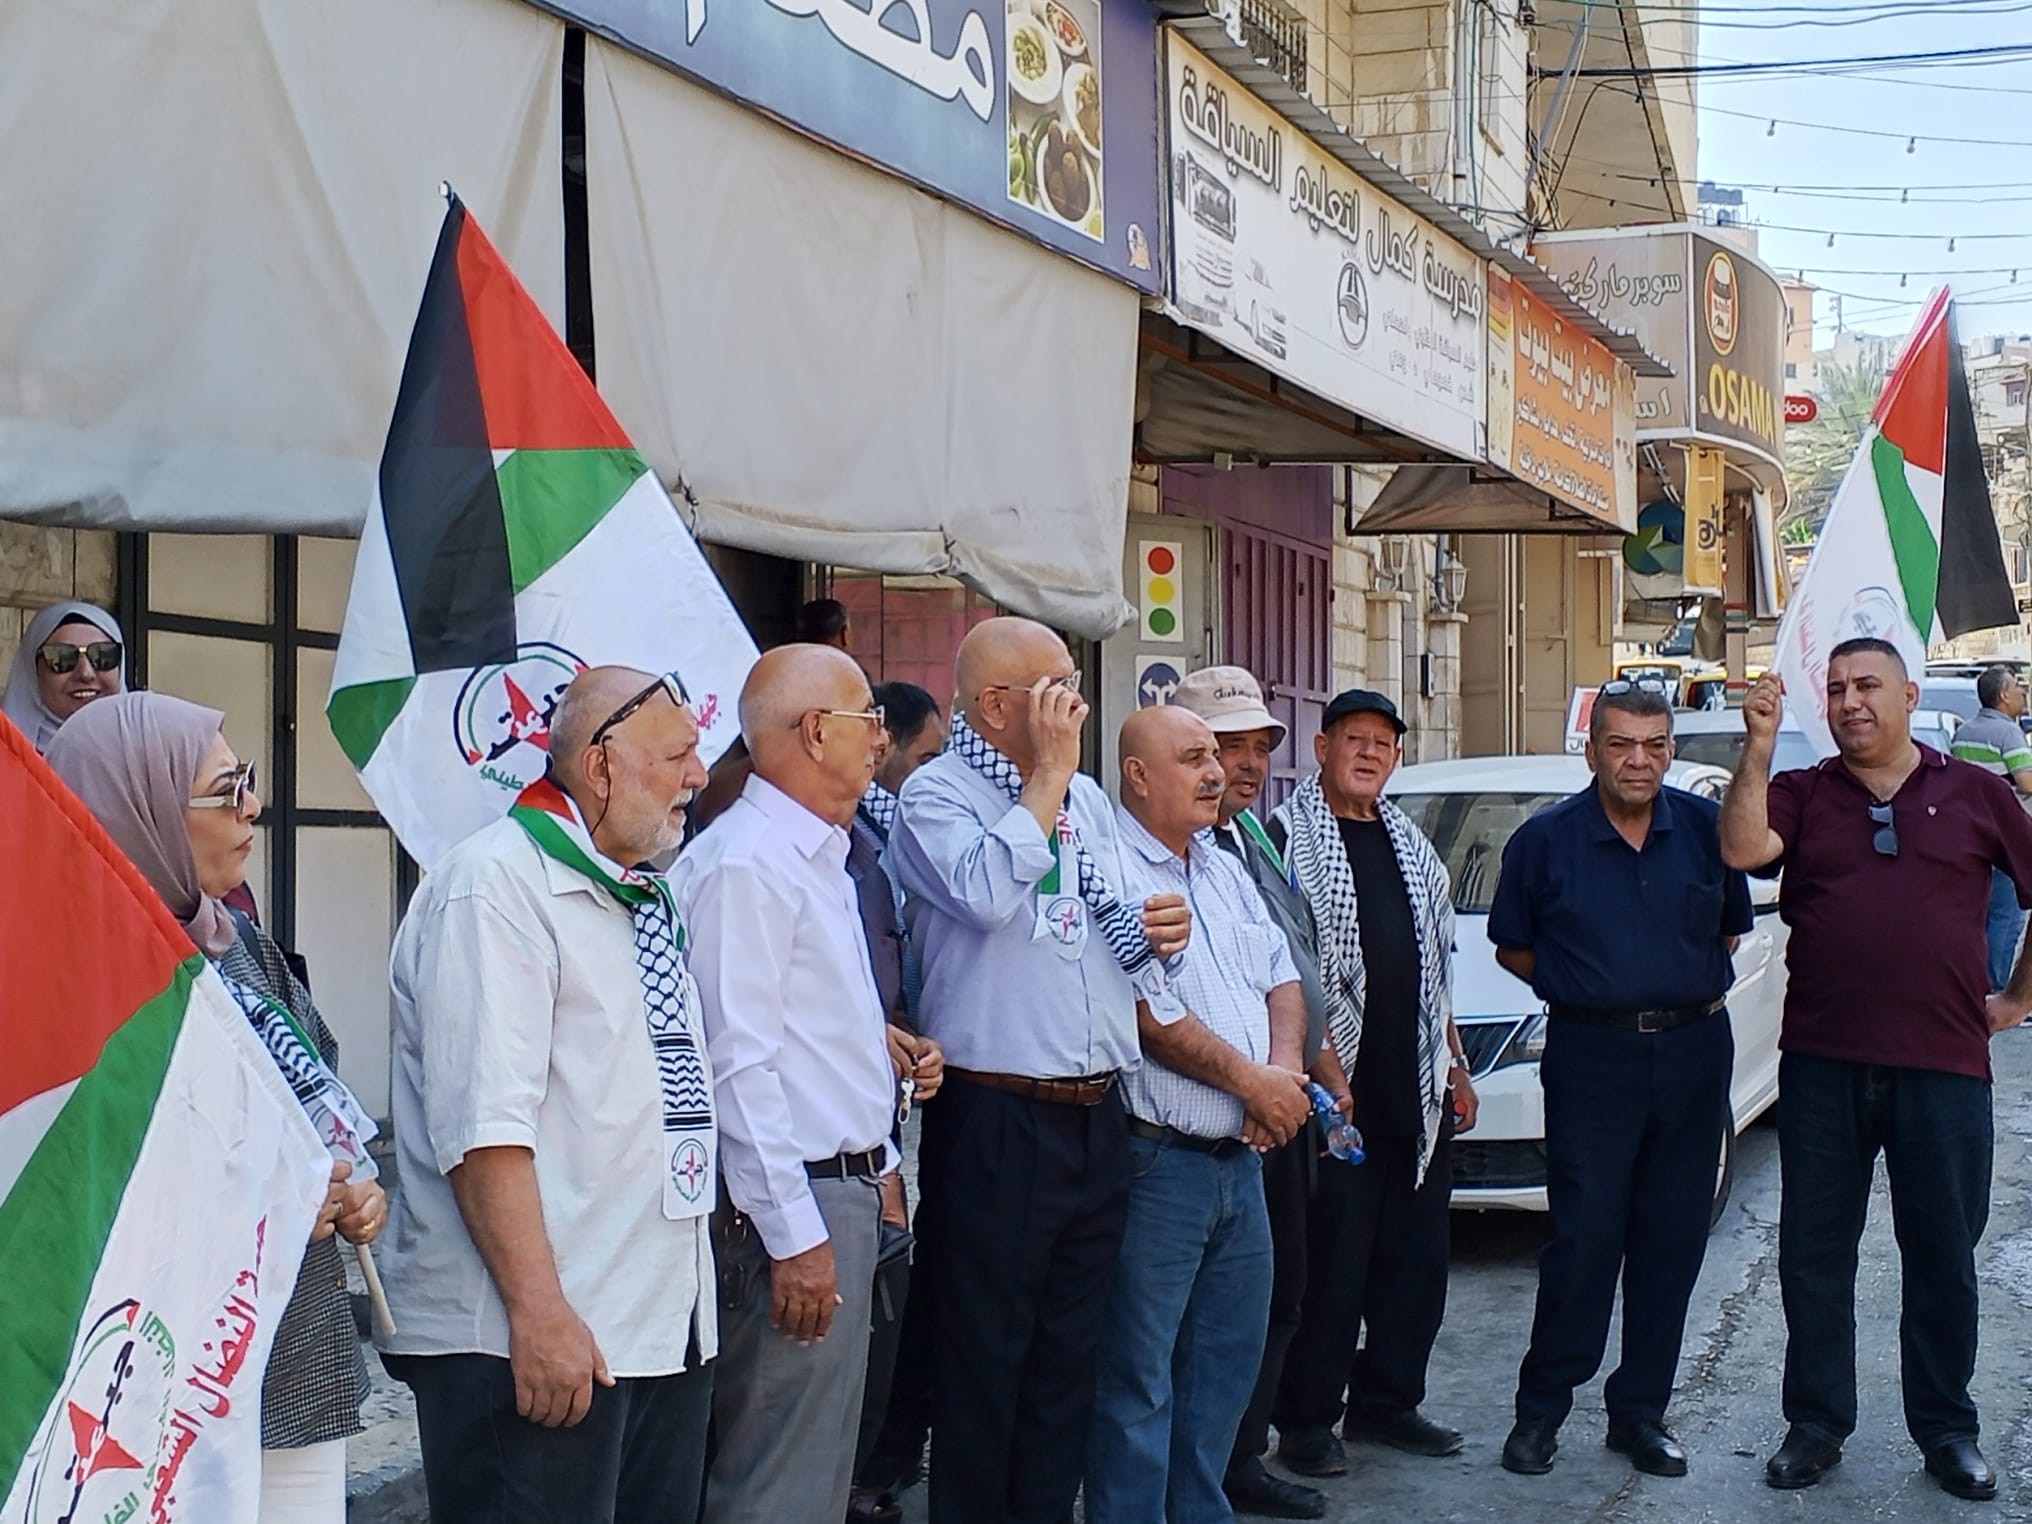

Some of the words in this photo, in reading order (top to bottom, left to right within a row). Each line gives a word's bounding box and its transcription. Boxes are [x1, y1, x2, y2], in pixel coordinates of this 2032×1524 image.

[1180, 65, 1282, 194] السياقة
[1290, 164, 1361, 245] لتعليم
[1366, 207, 1420, 283] كمال
[1422, 239, 1483, 327] مدرسة
[1709, 362, 1776, 446] OSAMA
[186, 1294, 259, 1419] النضال
